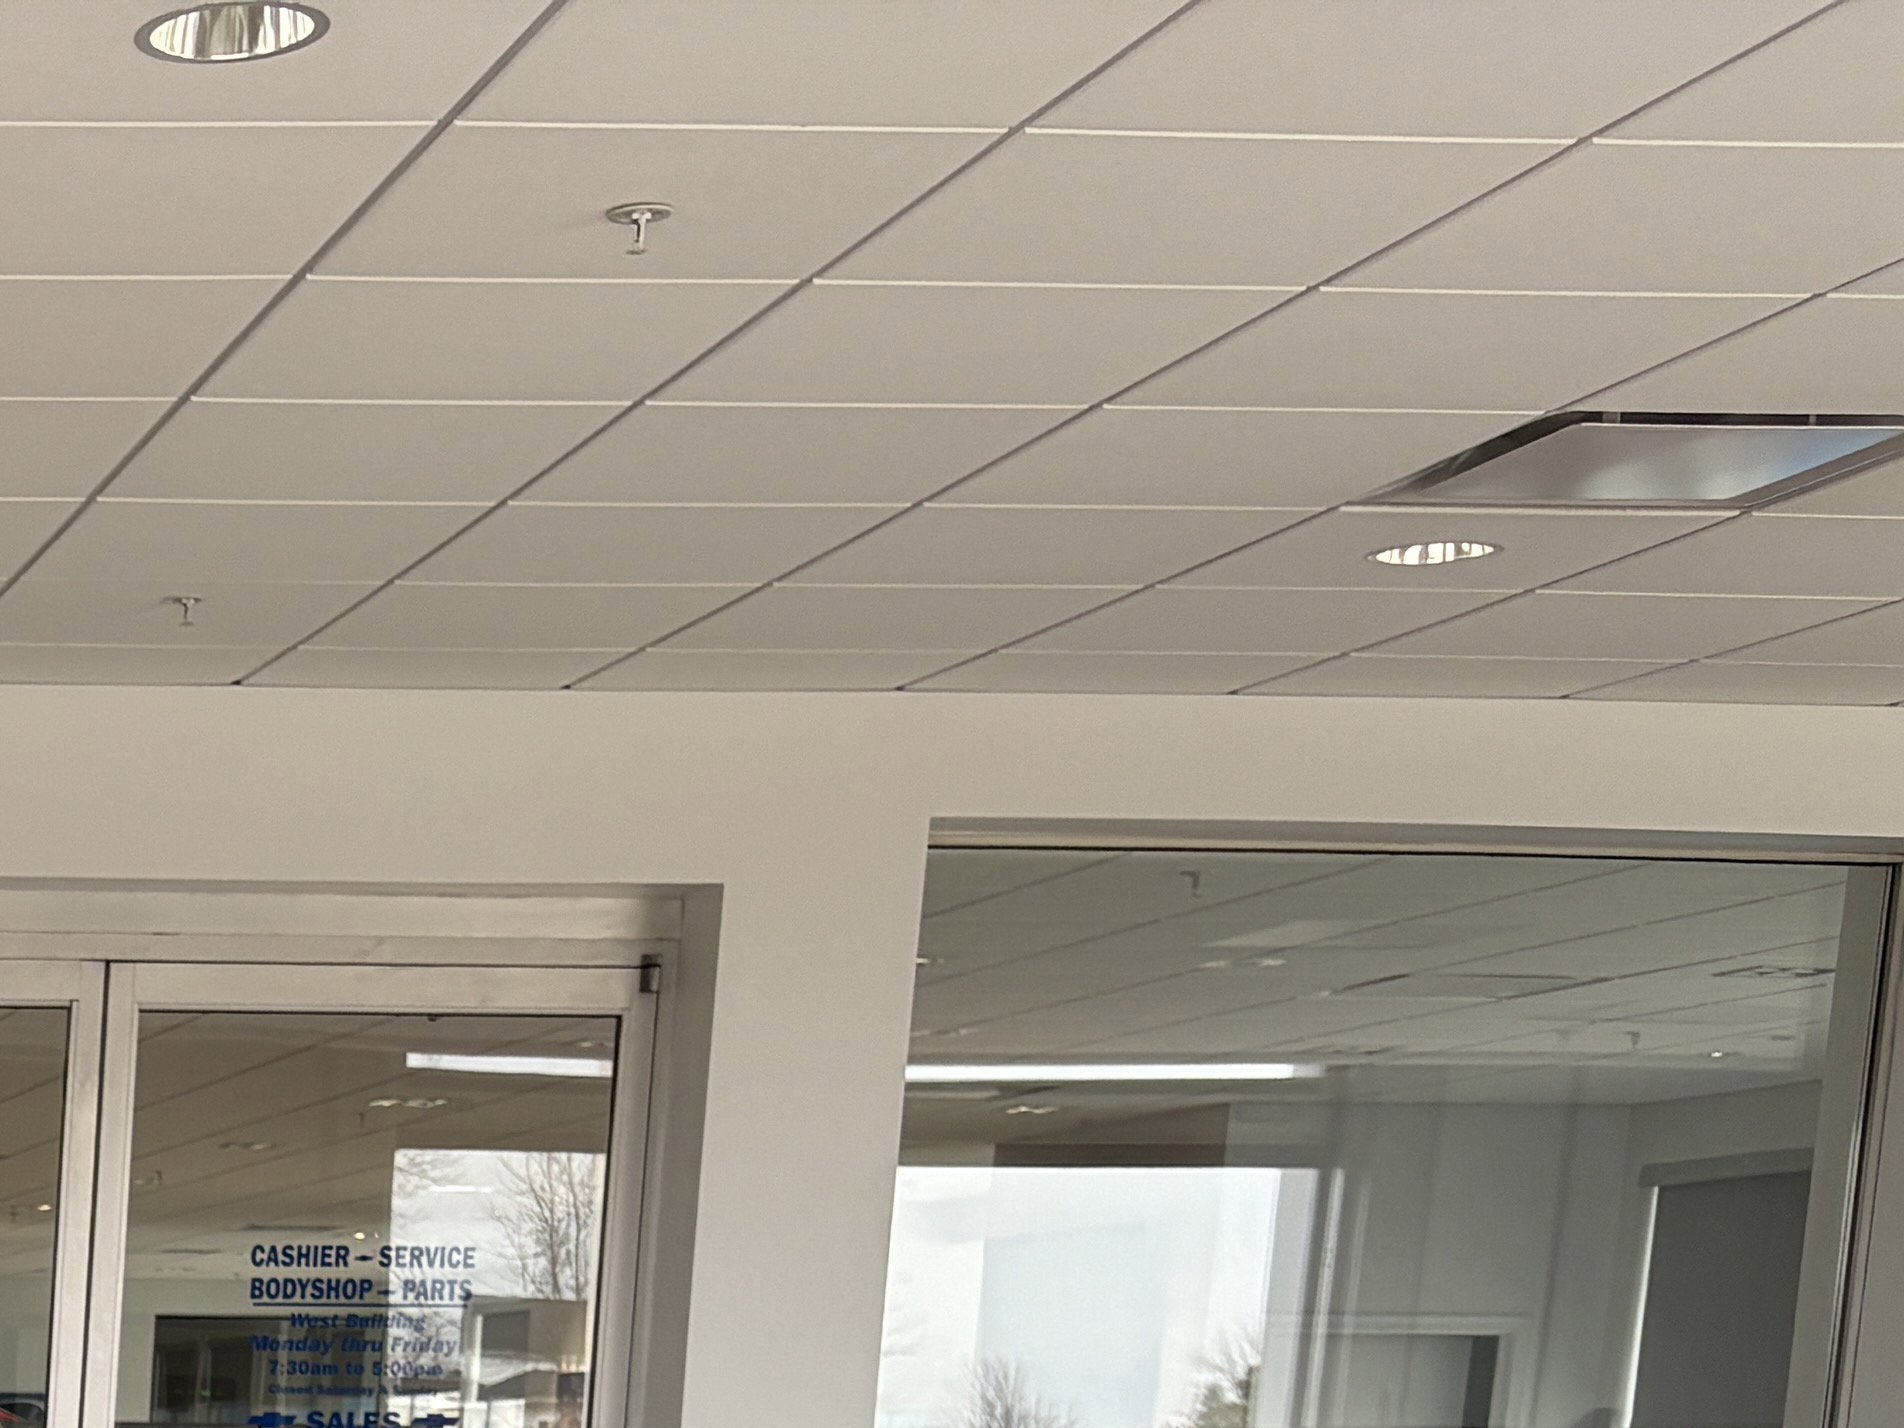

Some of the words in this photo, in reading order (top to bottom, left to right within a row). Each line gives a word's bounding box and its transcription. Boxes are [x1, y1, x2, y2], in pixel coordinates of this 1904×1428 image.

[251, 1245, 349, 1268] CASHIER
[379, 1246, 476, 1269] SERVICE
[251, 1278, 374, 1300] BODYSHOP
[402, 1279, 473, 1302] PARTS
[291, 1313, 339, 1329] West
[346, 1313, 425, 1332] Building
[250, 1336, 333, 1355] Monday
[342, 1337, 383, 1353] thru
[392, 1337, 457, 1356] Friday
[270, 1361, 338, 1376] 7:30am
[346, 1363, 364, 1376] to
[372, 1361, 443, 1378] 5:00pm
